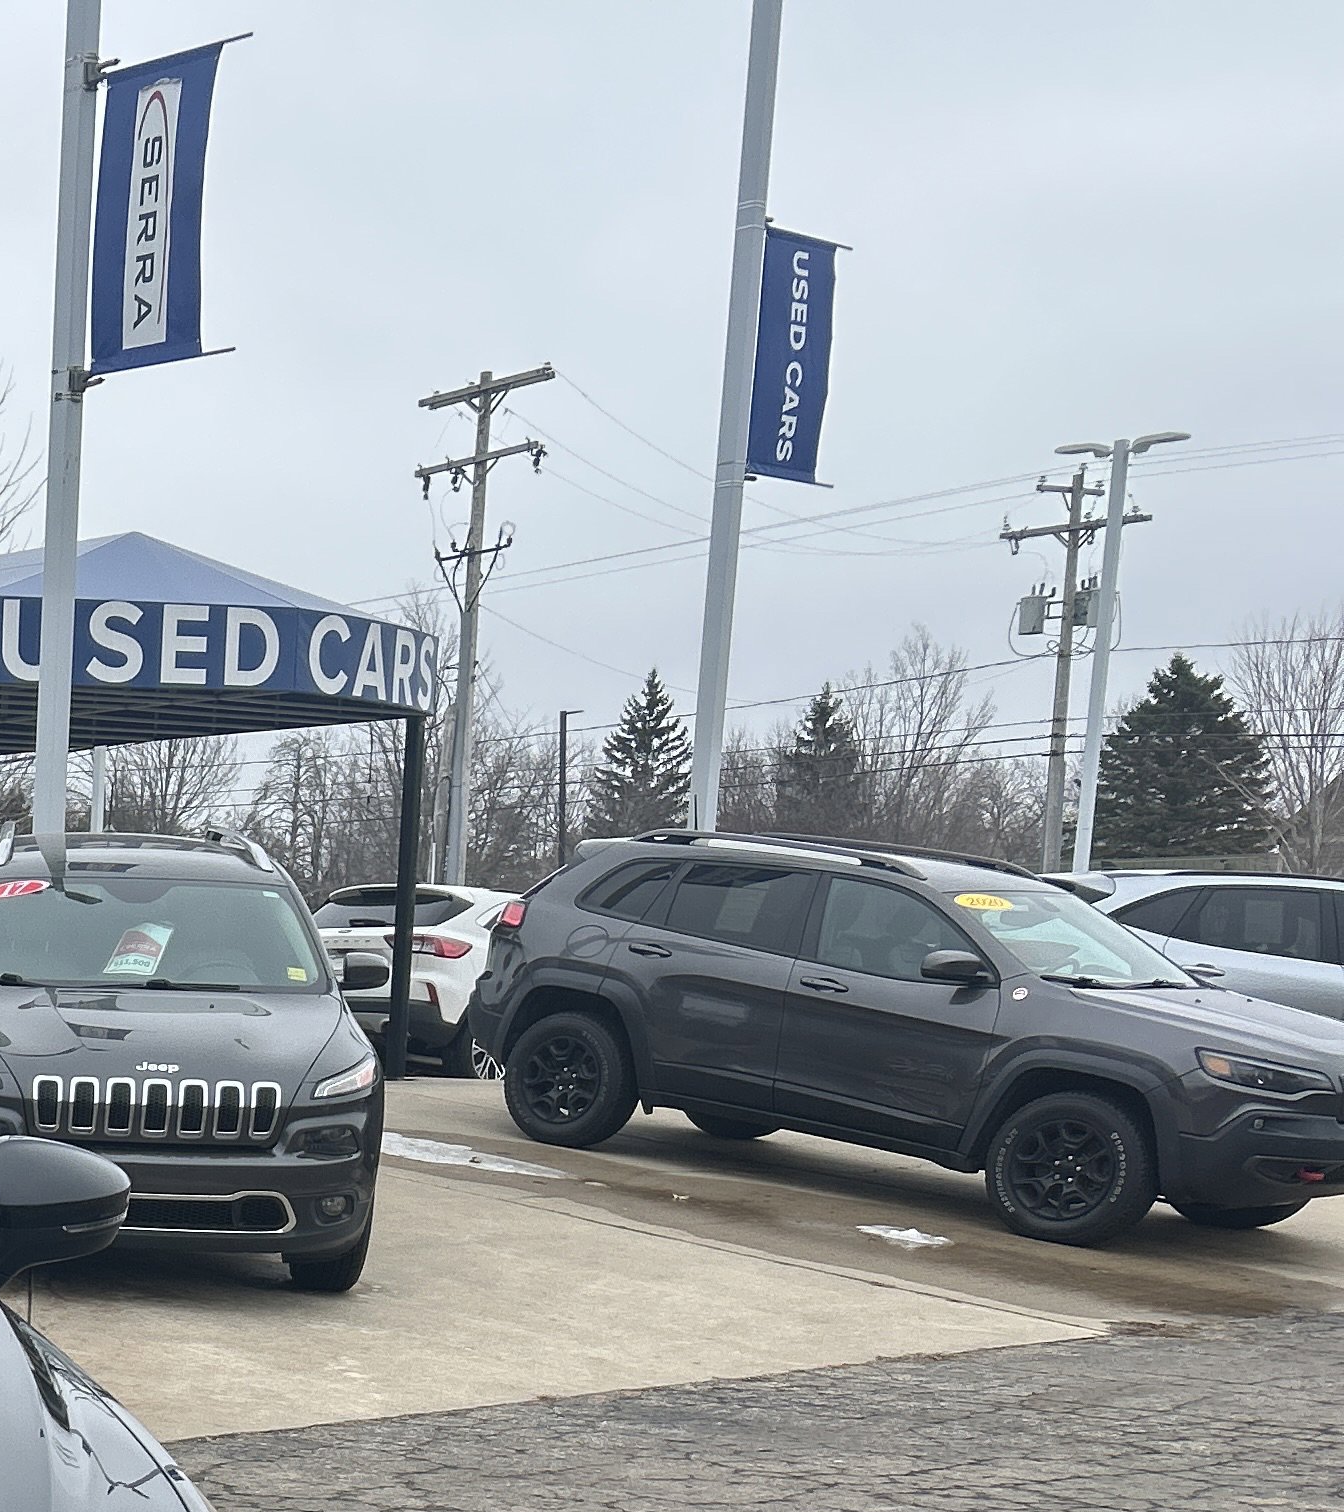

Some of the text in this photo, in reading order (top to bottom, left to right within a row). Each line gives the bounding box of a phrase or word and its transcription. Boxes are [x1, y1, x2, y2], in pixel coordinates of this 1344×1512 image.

[133, 135, 162, 330] SERRA
[776, 250, 809, 463] USED CARS
[2, 598, 435, 711] USED CARS
[135, 1061, 180, 1074] Jeep
